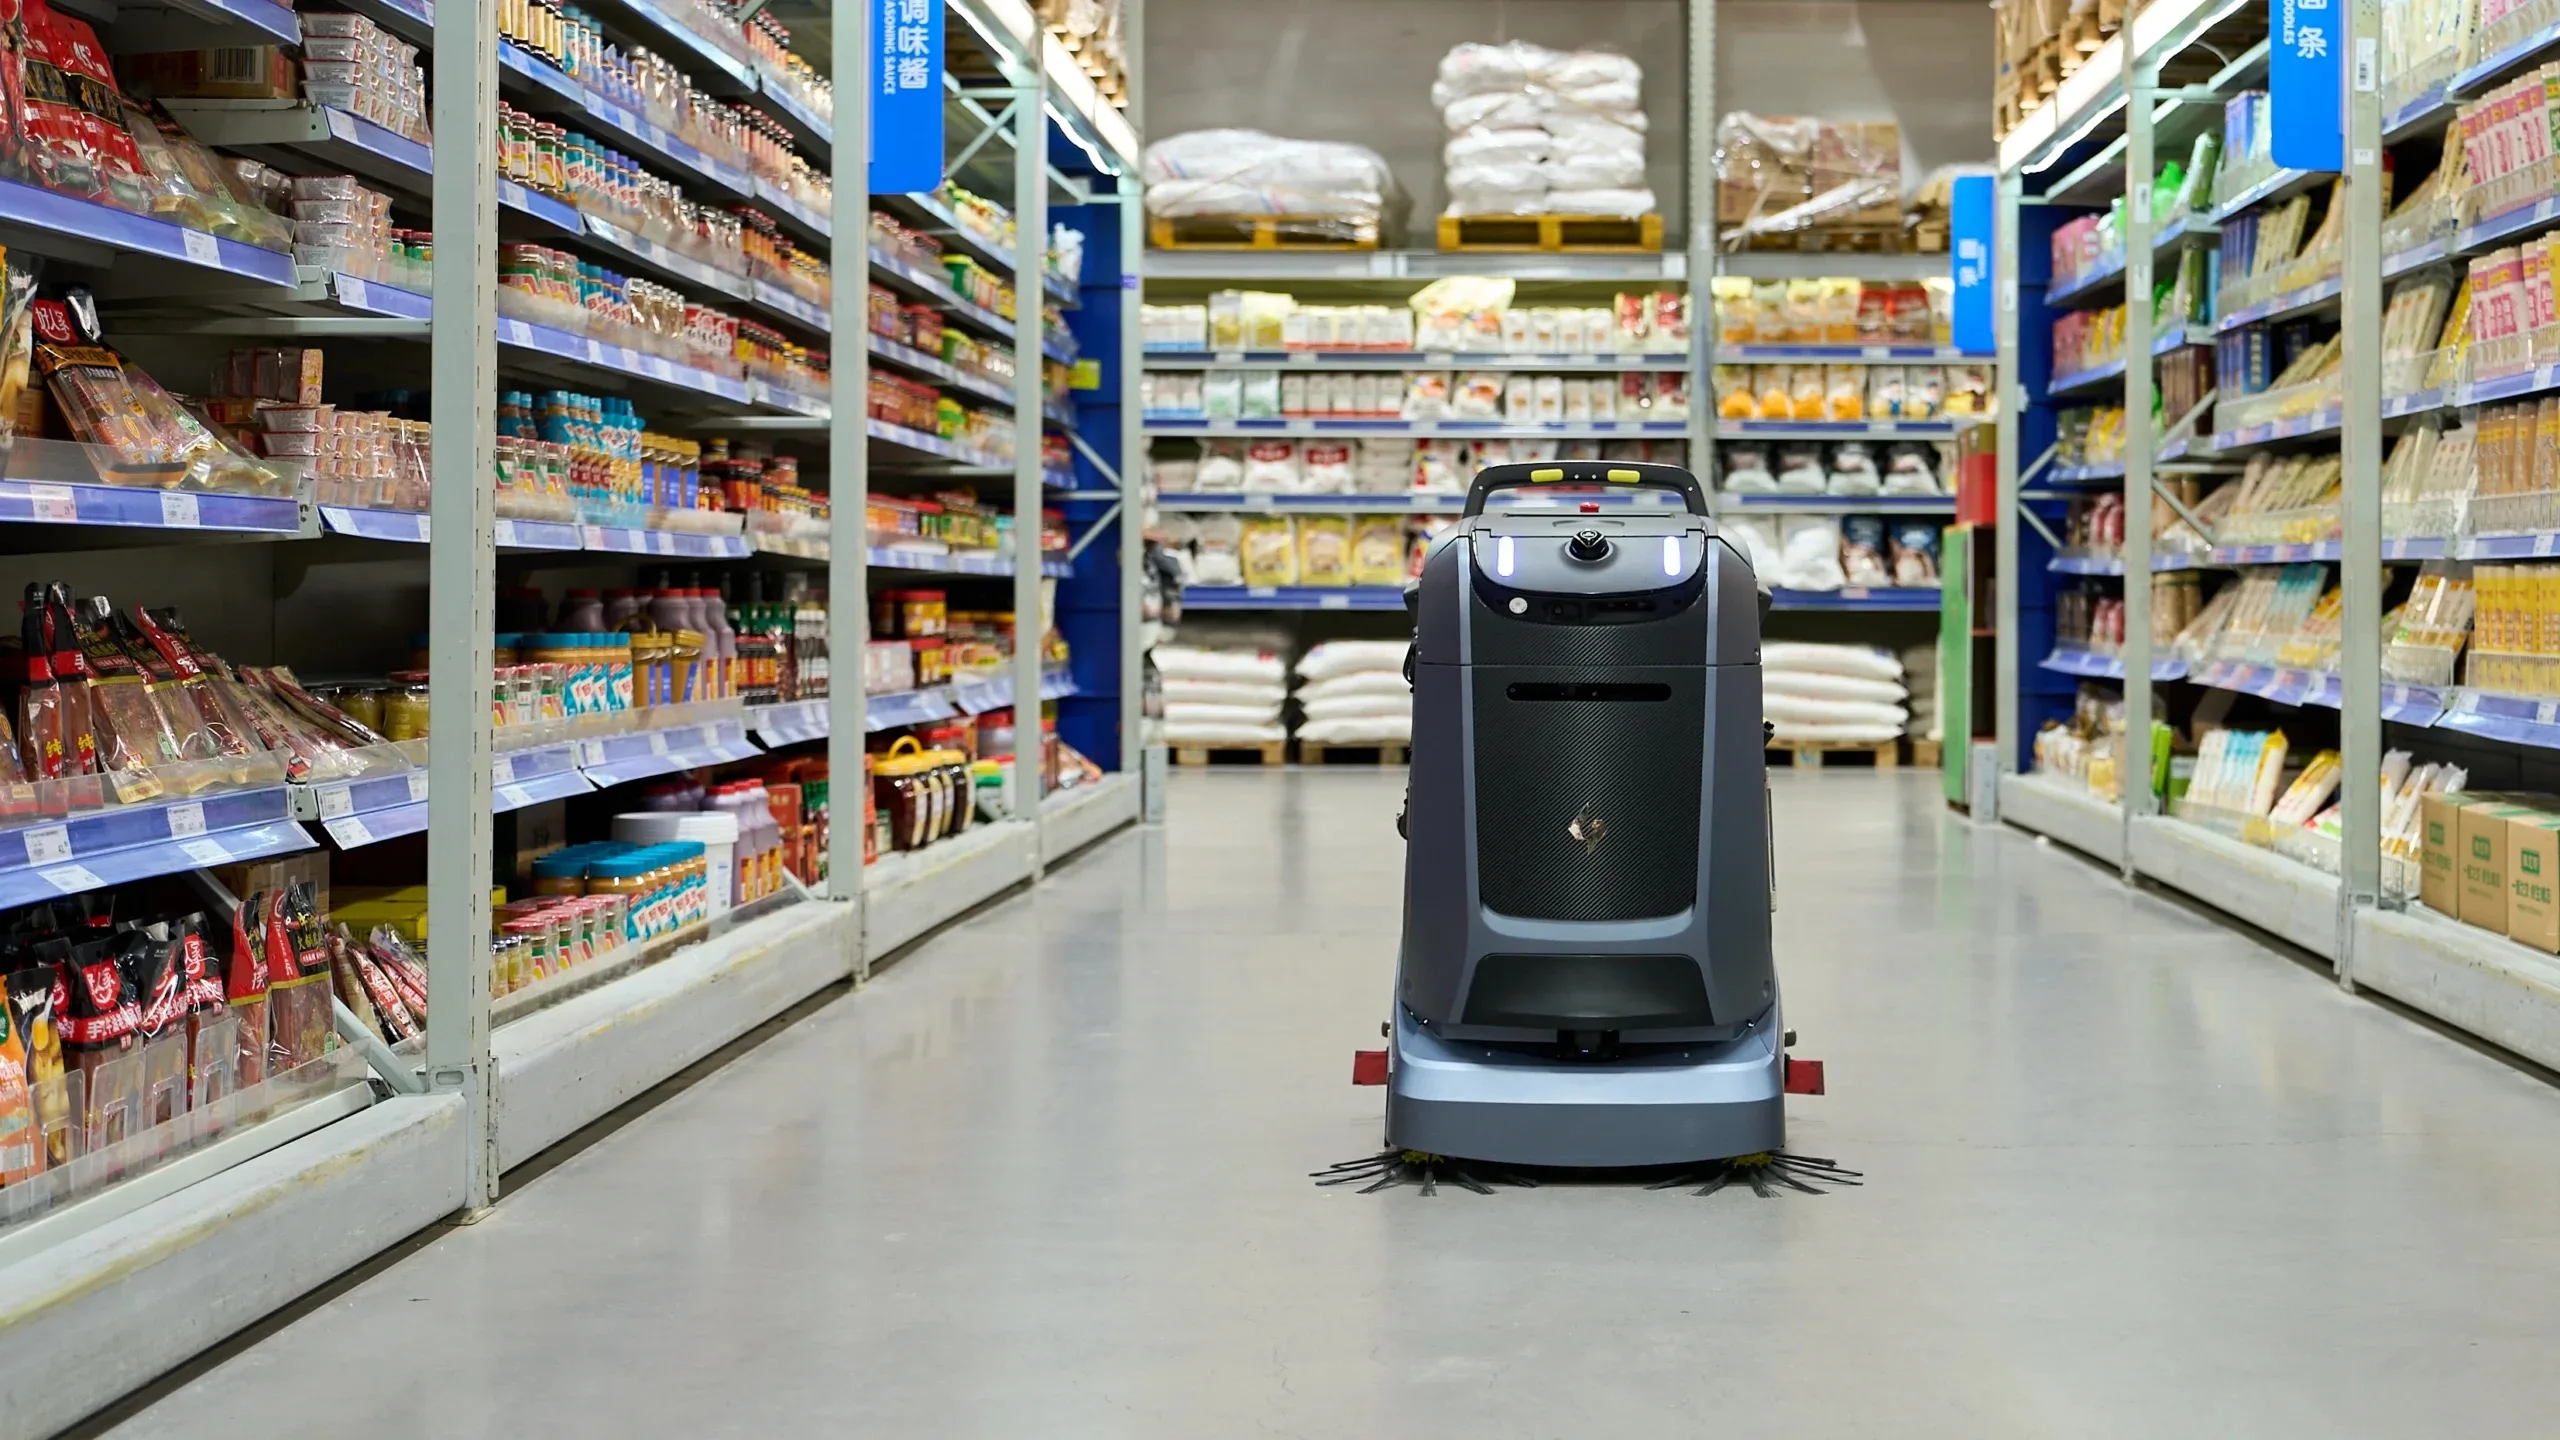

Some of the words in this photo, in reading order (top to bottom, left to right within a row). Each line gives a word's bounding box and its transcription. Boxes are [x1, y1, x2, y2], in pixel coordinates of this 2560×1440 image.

[883, 56, 896, 95] SAUCE
[897, 0, 930, 89] 调味酱
